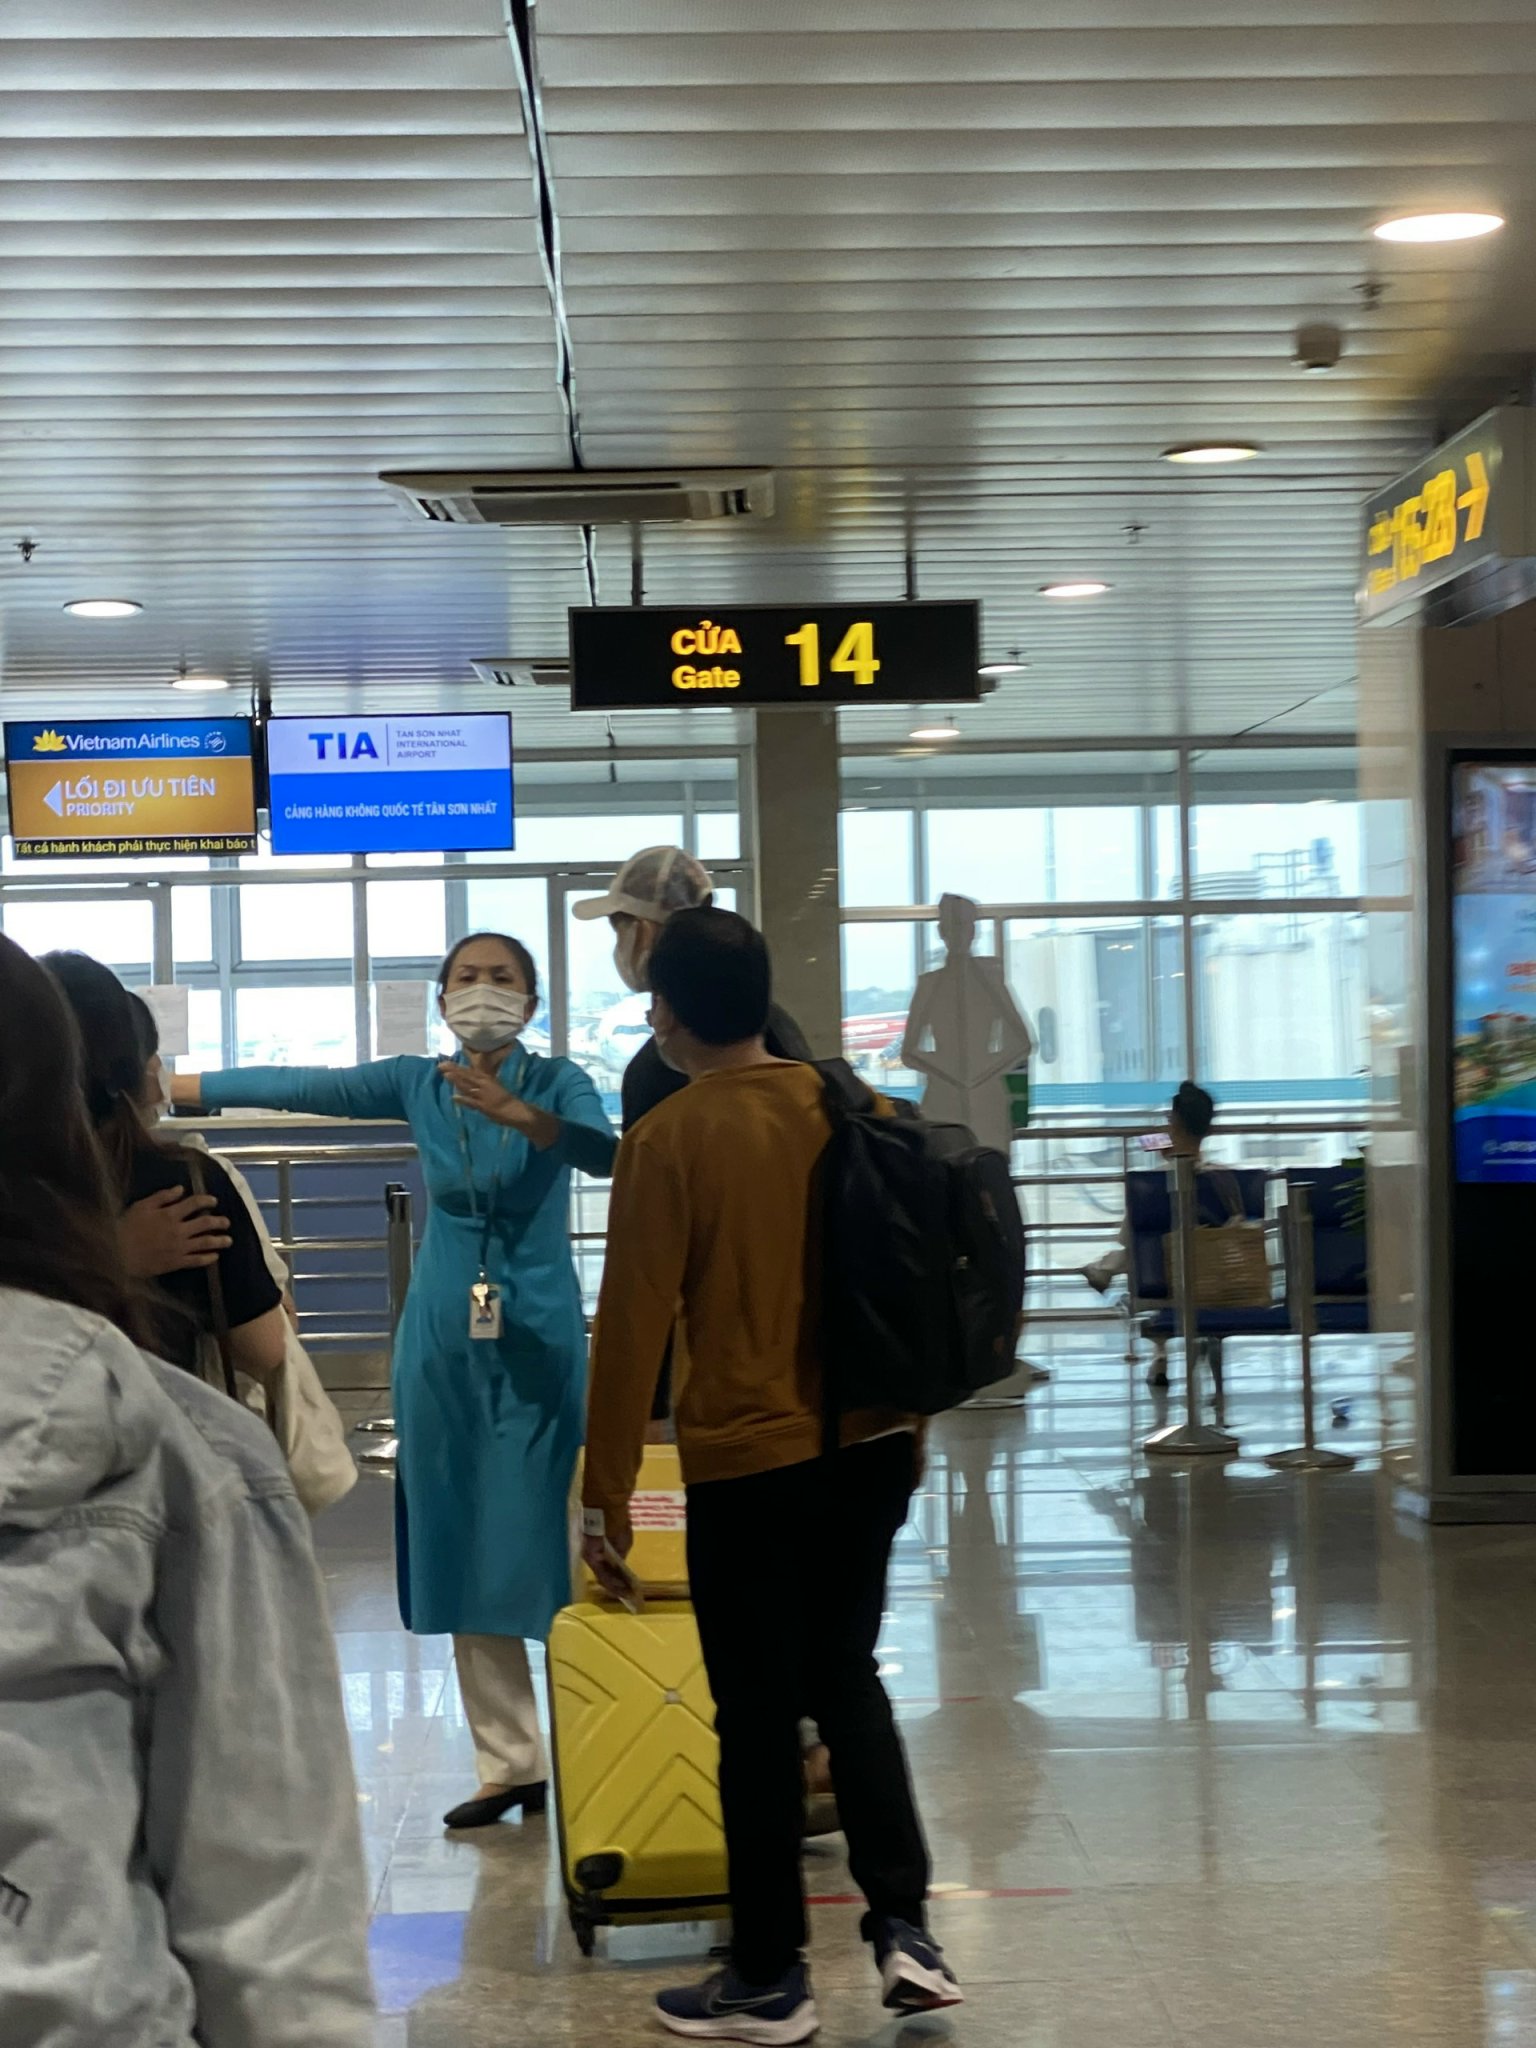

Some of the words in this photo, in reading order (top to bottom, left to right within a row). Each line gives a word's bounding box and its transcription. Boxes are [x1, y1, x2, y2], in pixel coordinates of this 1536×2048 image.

[671, 620, 742, 655] CỬA
[784, 622, 880, 686] 14
[671, 664, 741, 689] Gate
[66, 733, 136, 750] Vietnam
[138, 732, 200, 749] Airlines
[396, 730, 414, 738] TAN
[416, 730, 435, 738] SON
[437, 729, 462, 737] NHAT
[308, 732, 379, 760] TIA
[396, 739, 467, 748] INTERNATIONAL
[396, 750, 437, 759] AIRPORT
[65, 775, 98, 799] LỐI
[103, 779, 126, 798] ĐI
[132, 777, 164, 797] ƯU
[168, 775, 217, 797] TIÊN
[66, 802, 135, 816] PRIORITY
[345, 802, 380, 817] KHÔNG
[382, 801, 410, 817] QUỐC
[425, 801, 446, 816] TÂN
[82, 840, 116, 852] khách
[145, 839, 171, 852] thực
[174, 839, 198, 852] hiện
[200, 838, 224, 850] khai
[226, 838, 248, 849] báo
